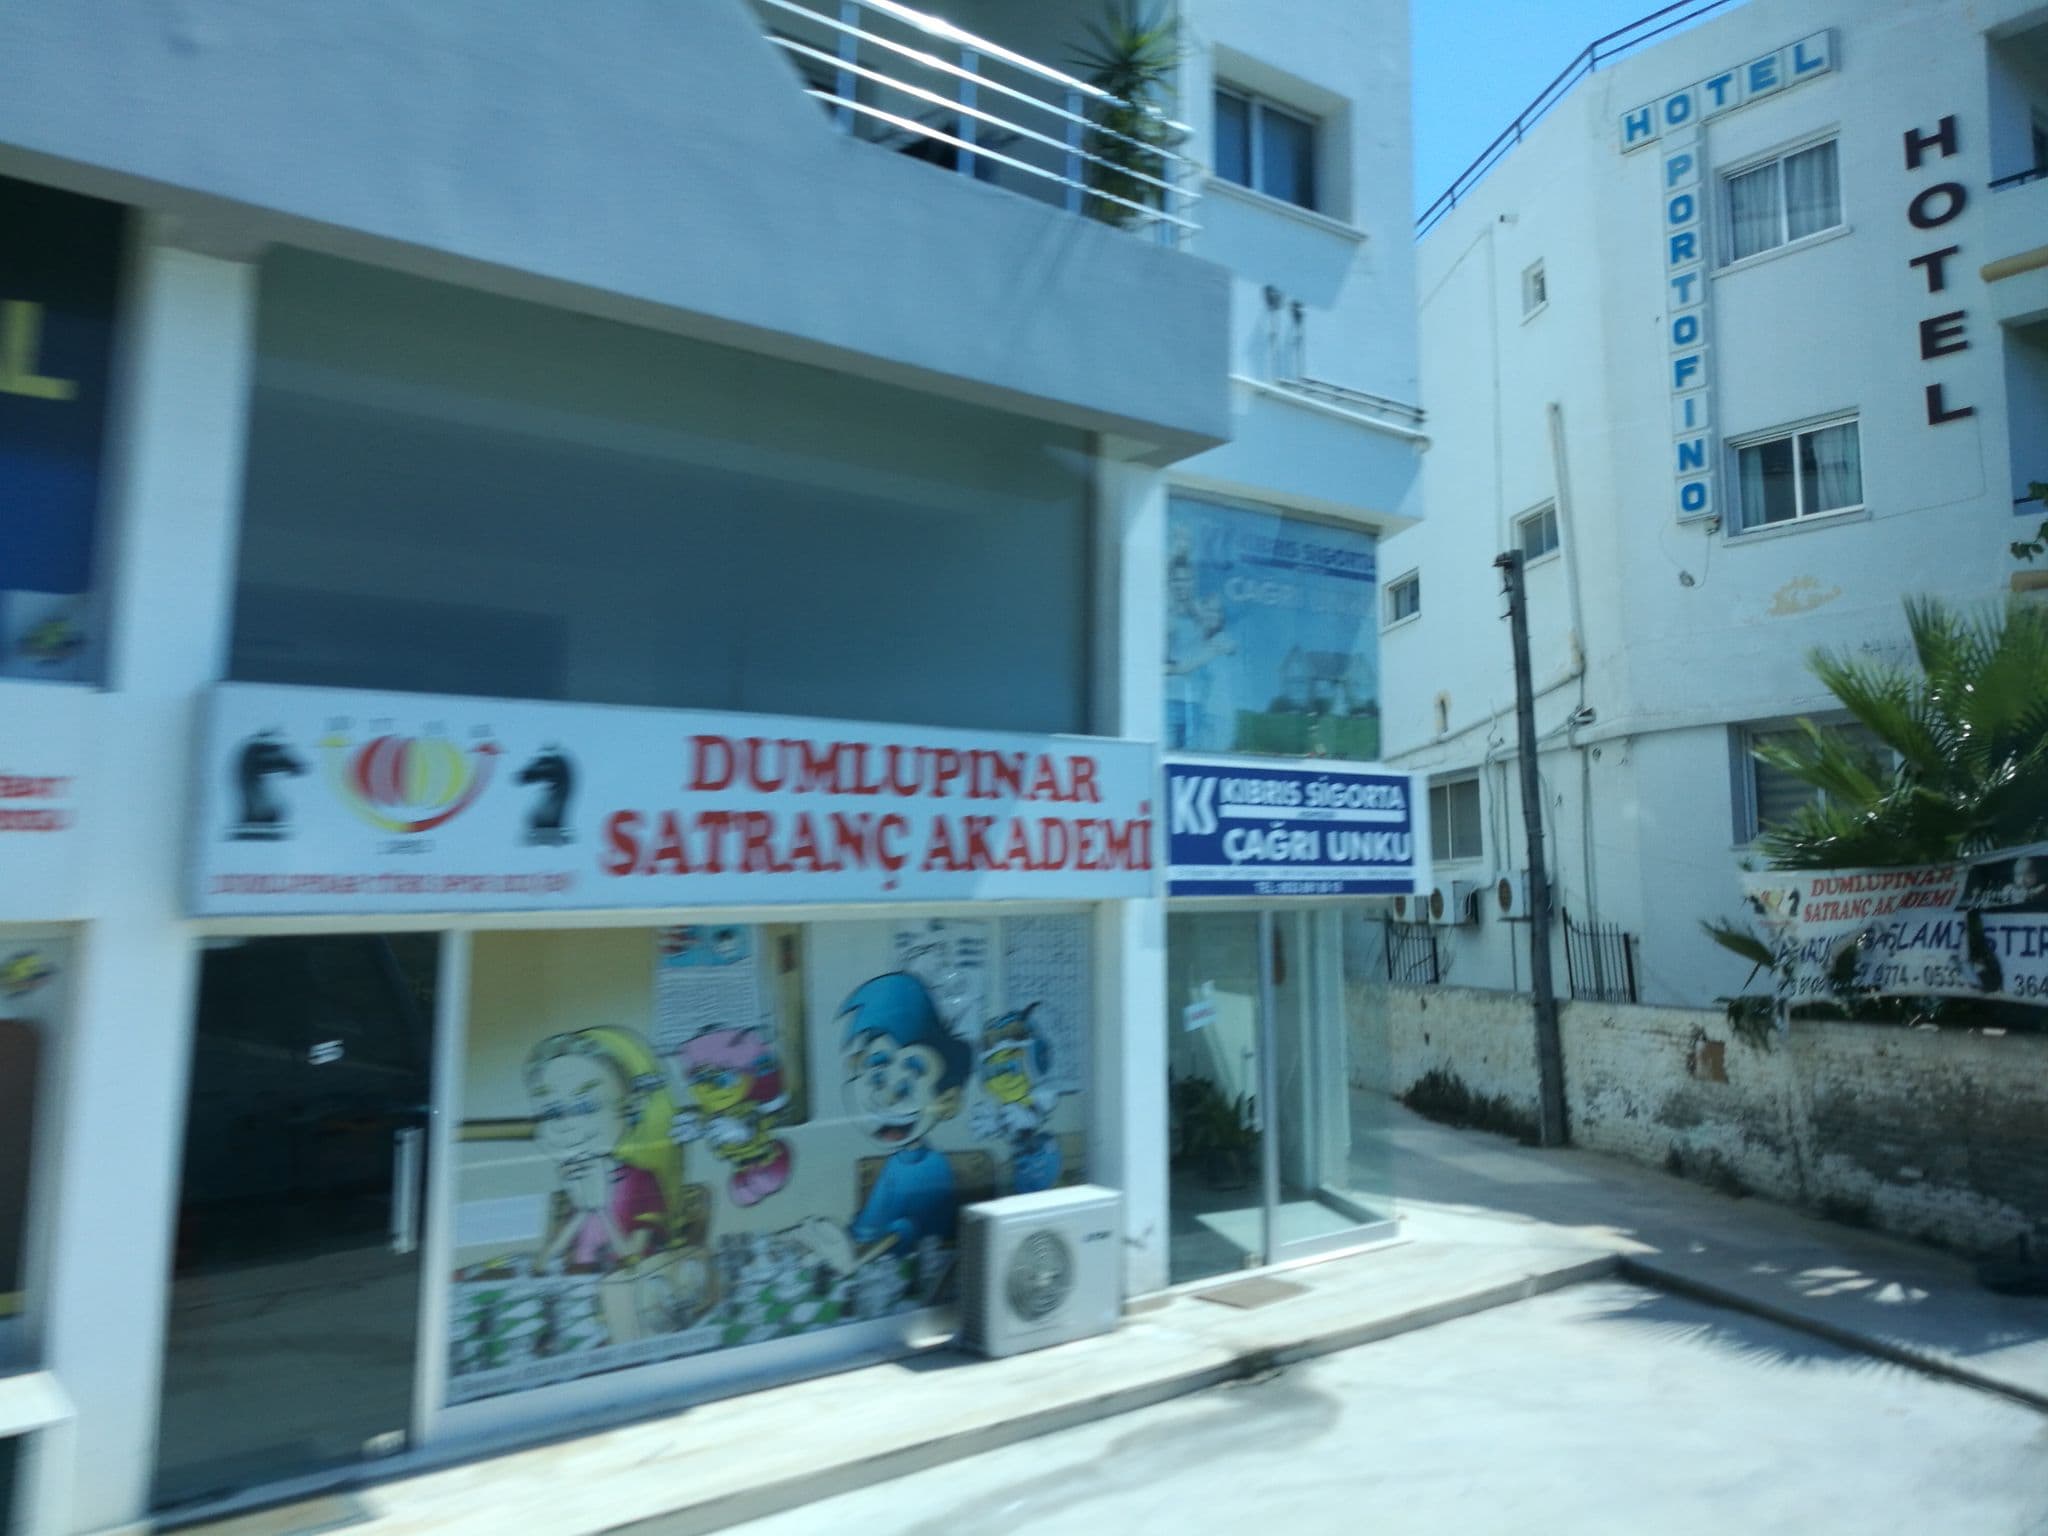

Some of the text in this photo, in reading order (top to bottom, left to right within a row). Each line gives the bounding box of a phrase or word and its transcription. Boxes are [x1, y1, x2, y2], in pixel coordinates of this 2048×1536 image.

[1624, 41, 1824, 145] HOTEL
[1903, 113, 1974, 426] HOTEL
[1665, 153, 1709, 514] PORTOFINO
[686, 734, 1101, 804] DUMLUPINAR
[1219, 775, 1406, 811] KIBRIS SİGORTA
[600, 800, 1153, 891] SATRANÇ AKADEMİ
[1221, 820, 1411, 867] ÇAĞRI UNKU
[1810, 867, 1956, 897] DUMLUPINAR
